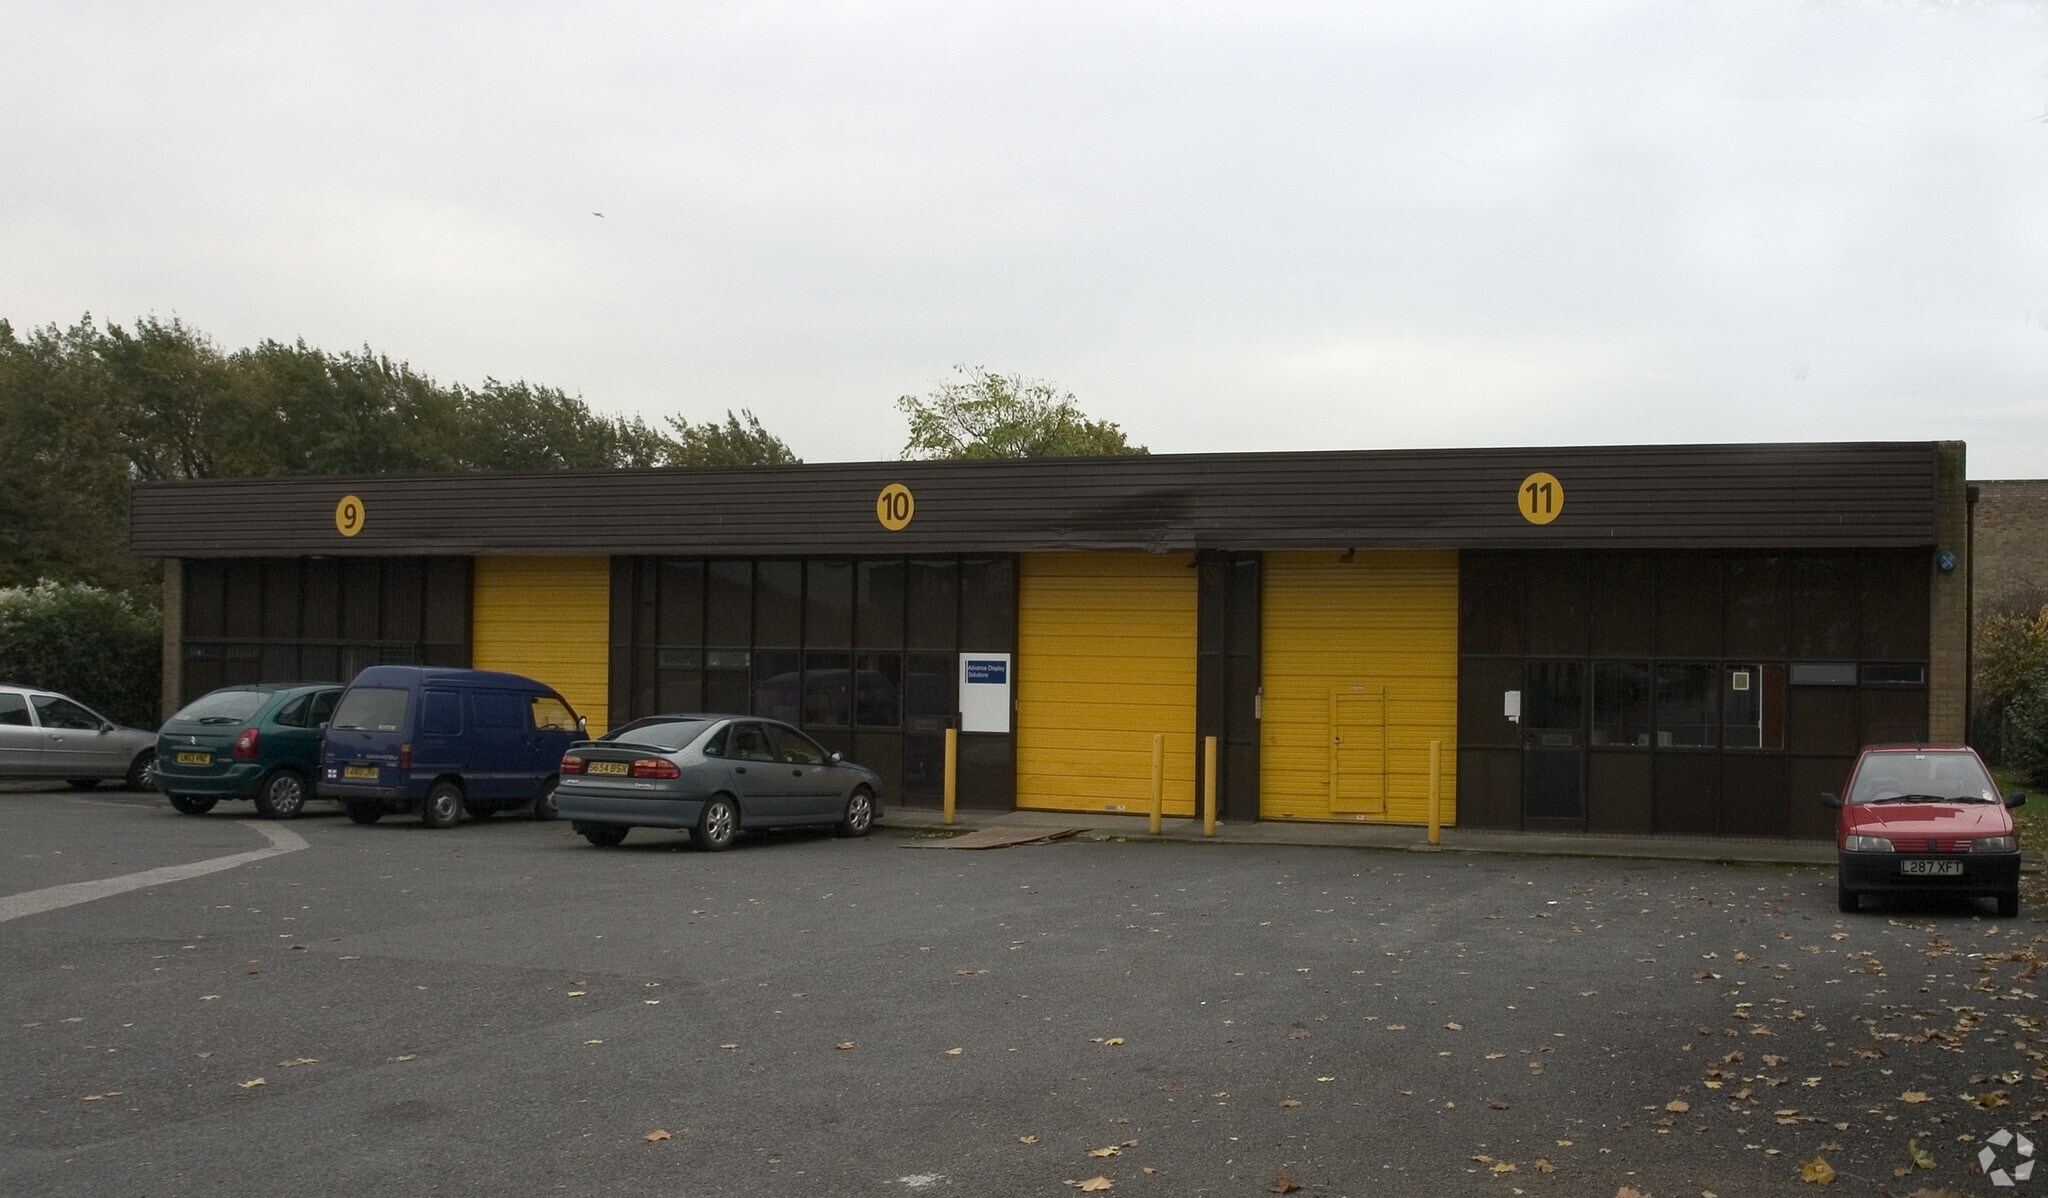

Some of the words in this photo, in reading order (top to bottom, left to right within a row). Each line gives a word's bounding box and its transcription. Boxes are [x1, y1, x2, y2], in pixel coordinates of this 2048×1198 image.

[882, 492, 909, 521] 10
[1525, 482, 1552, 514] 11
[344, 503, 357, 530] 9
[589, 763, 609, 772] S654
[610, 764, 627, 774] BSX
[1902, 861, 1934, 873] L287
[1938, 861, 1961, 873] XFT
